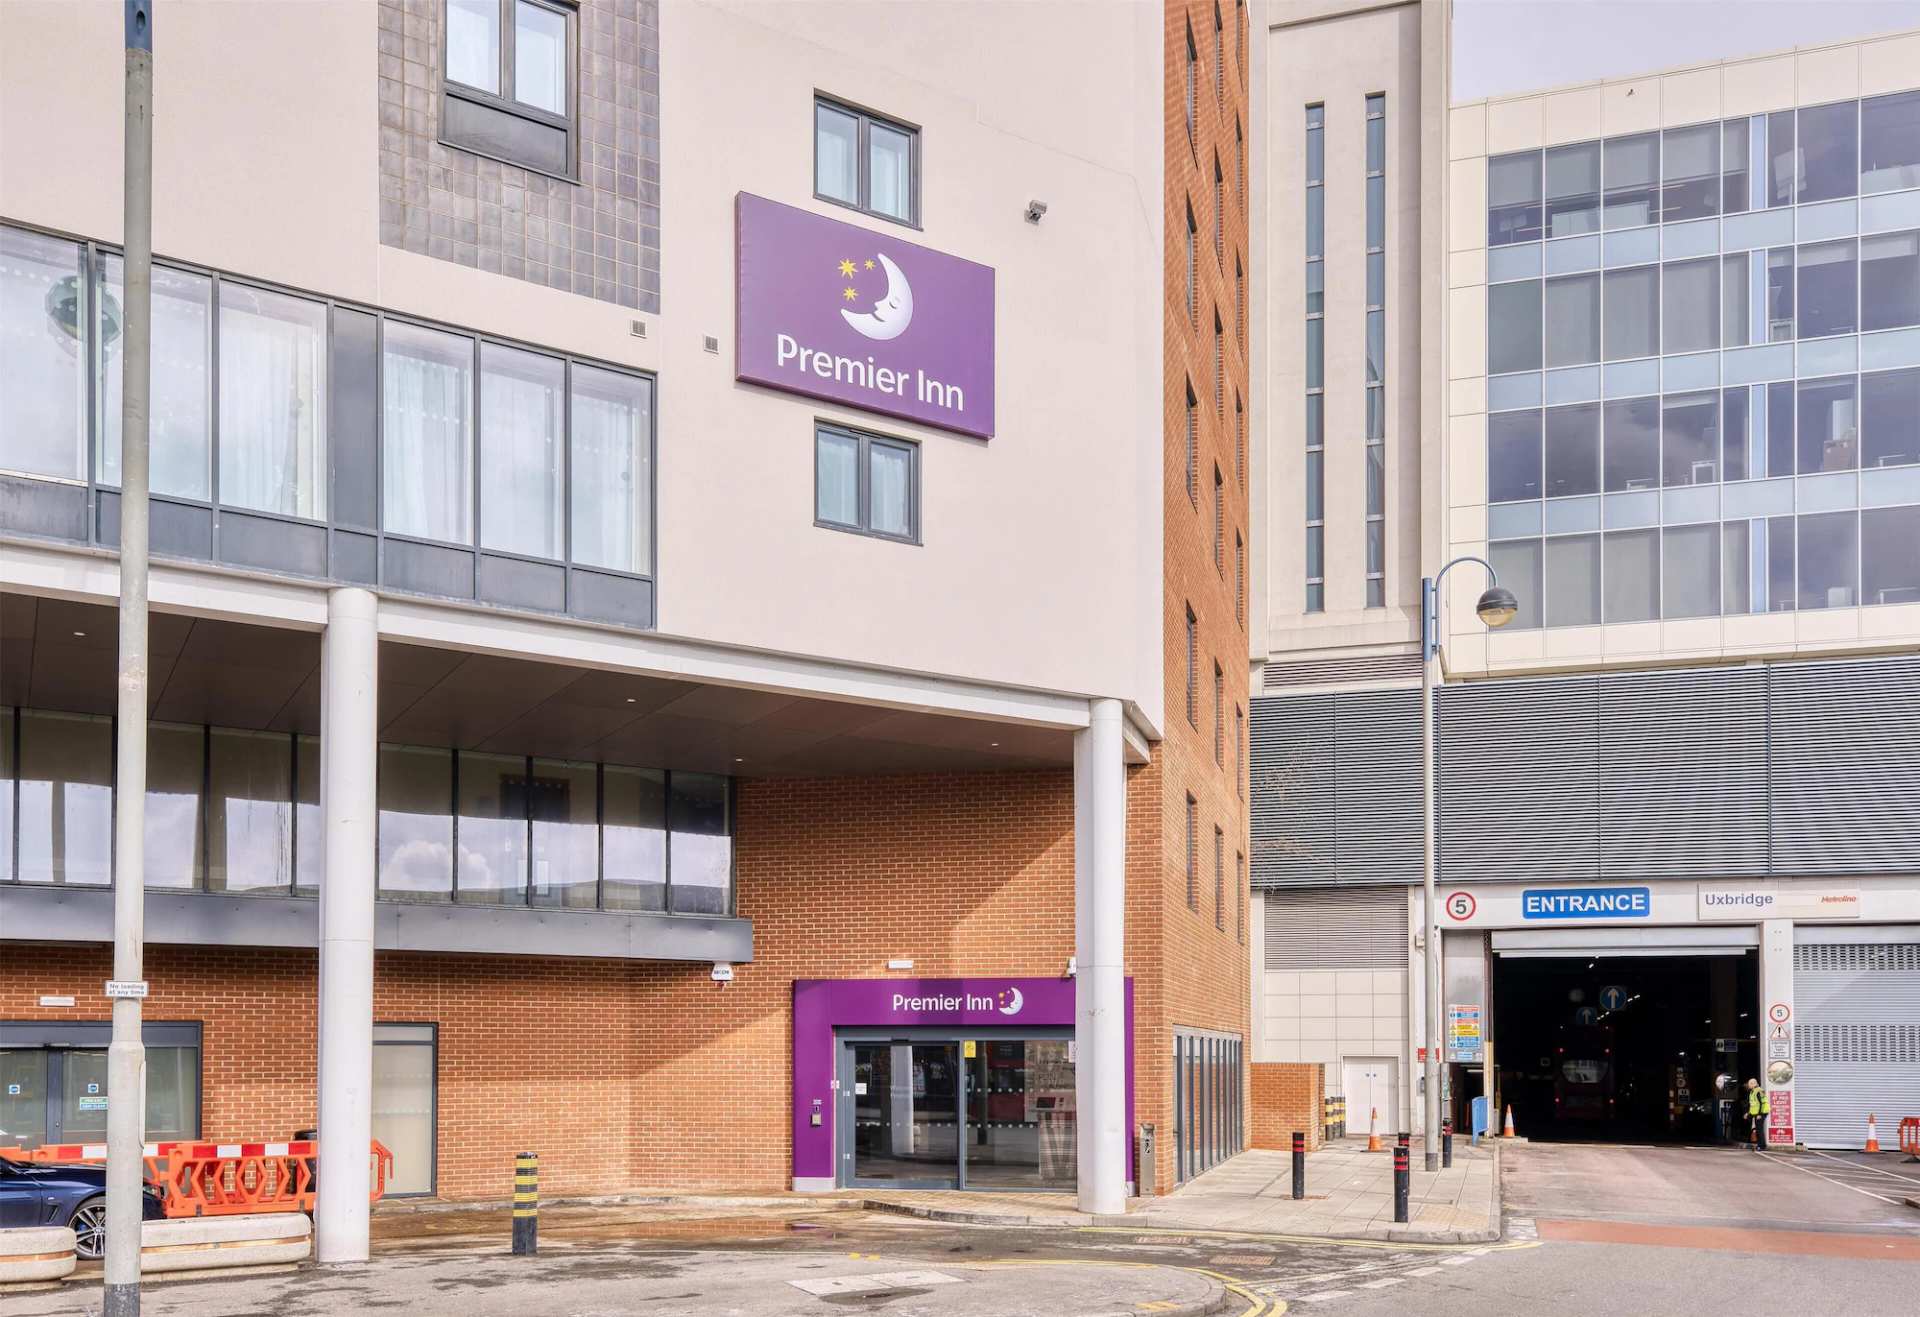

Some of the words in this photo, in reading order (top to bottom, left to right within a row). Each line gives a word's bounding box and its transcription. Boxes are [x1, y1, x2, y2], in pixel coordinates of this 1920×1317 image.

[777, 333, 910, 396] Premier
[918, 368, 964, 412] Inn
[1455, 899, 1467, 915] 5
[1527, 894, 1646, 912] ENTRANCE
[1704, 892, 1774, 907] Uxbridge
[893, 993, 962, 1011] Premier
[966, 993, 994, 1011] Inn
[1776, 1008, 1783, 1017] 5
